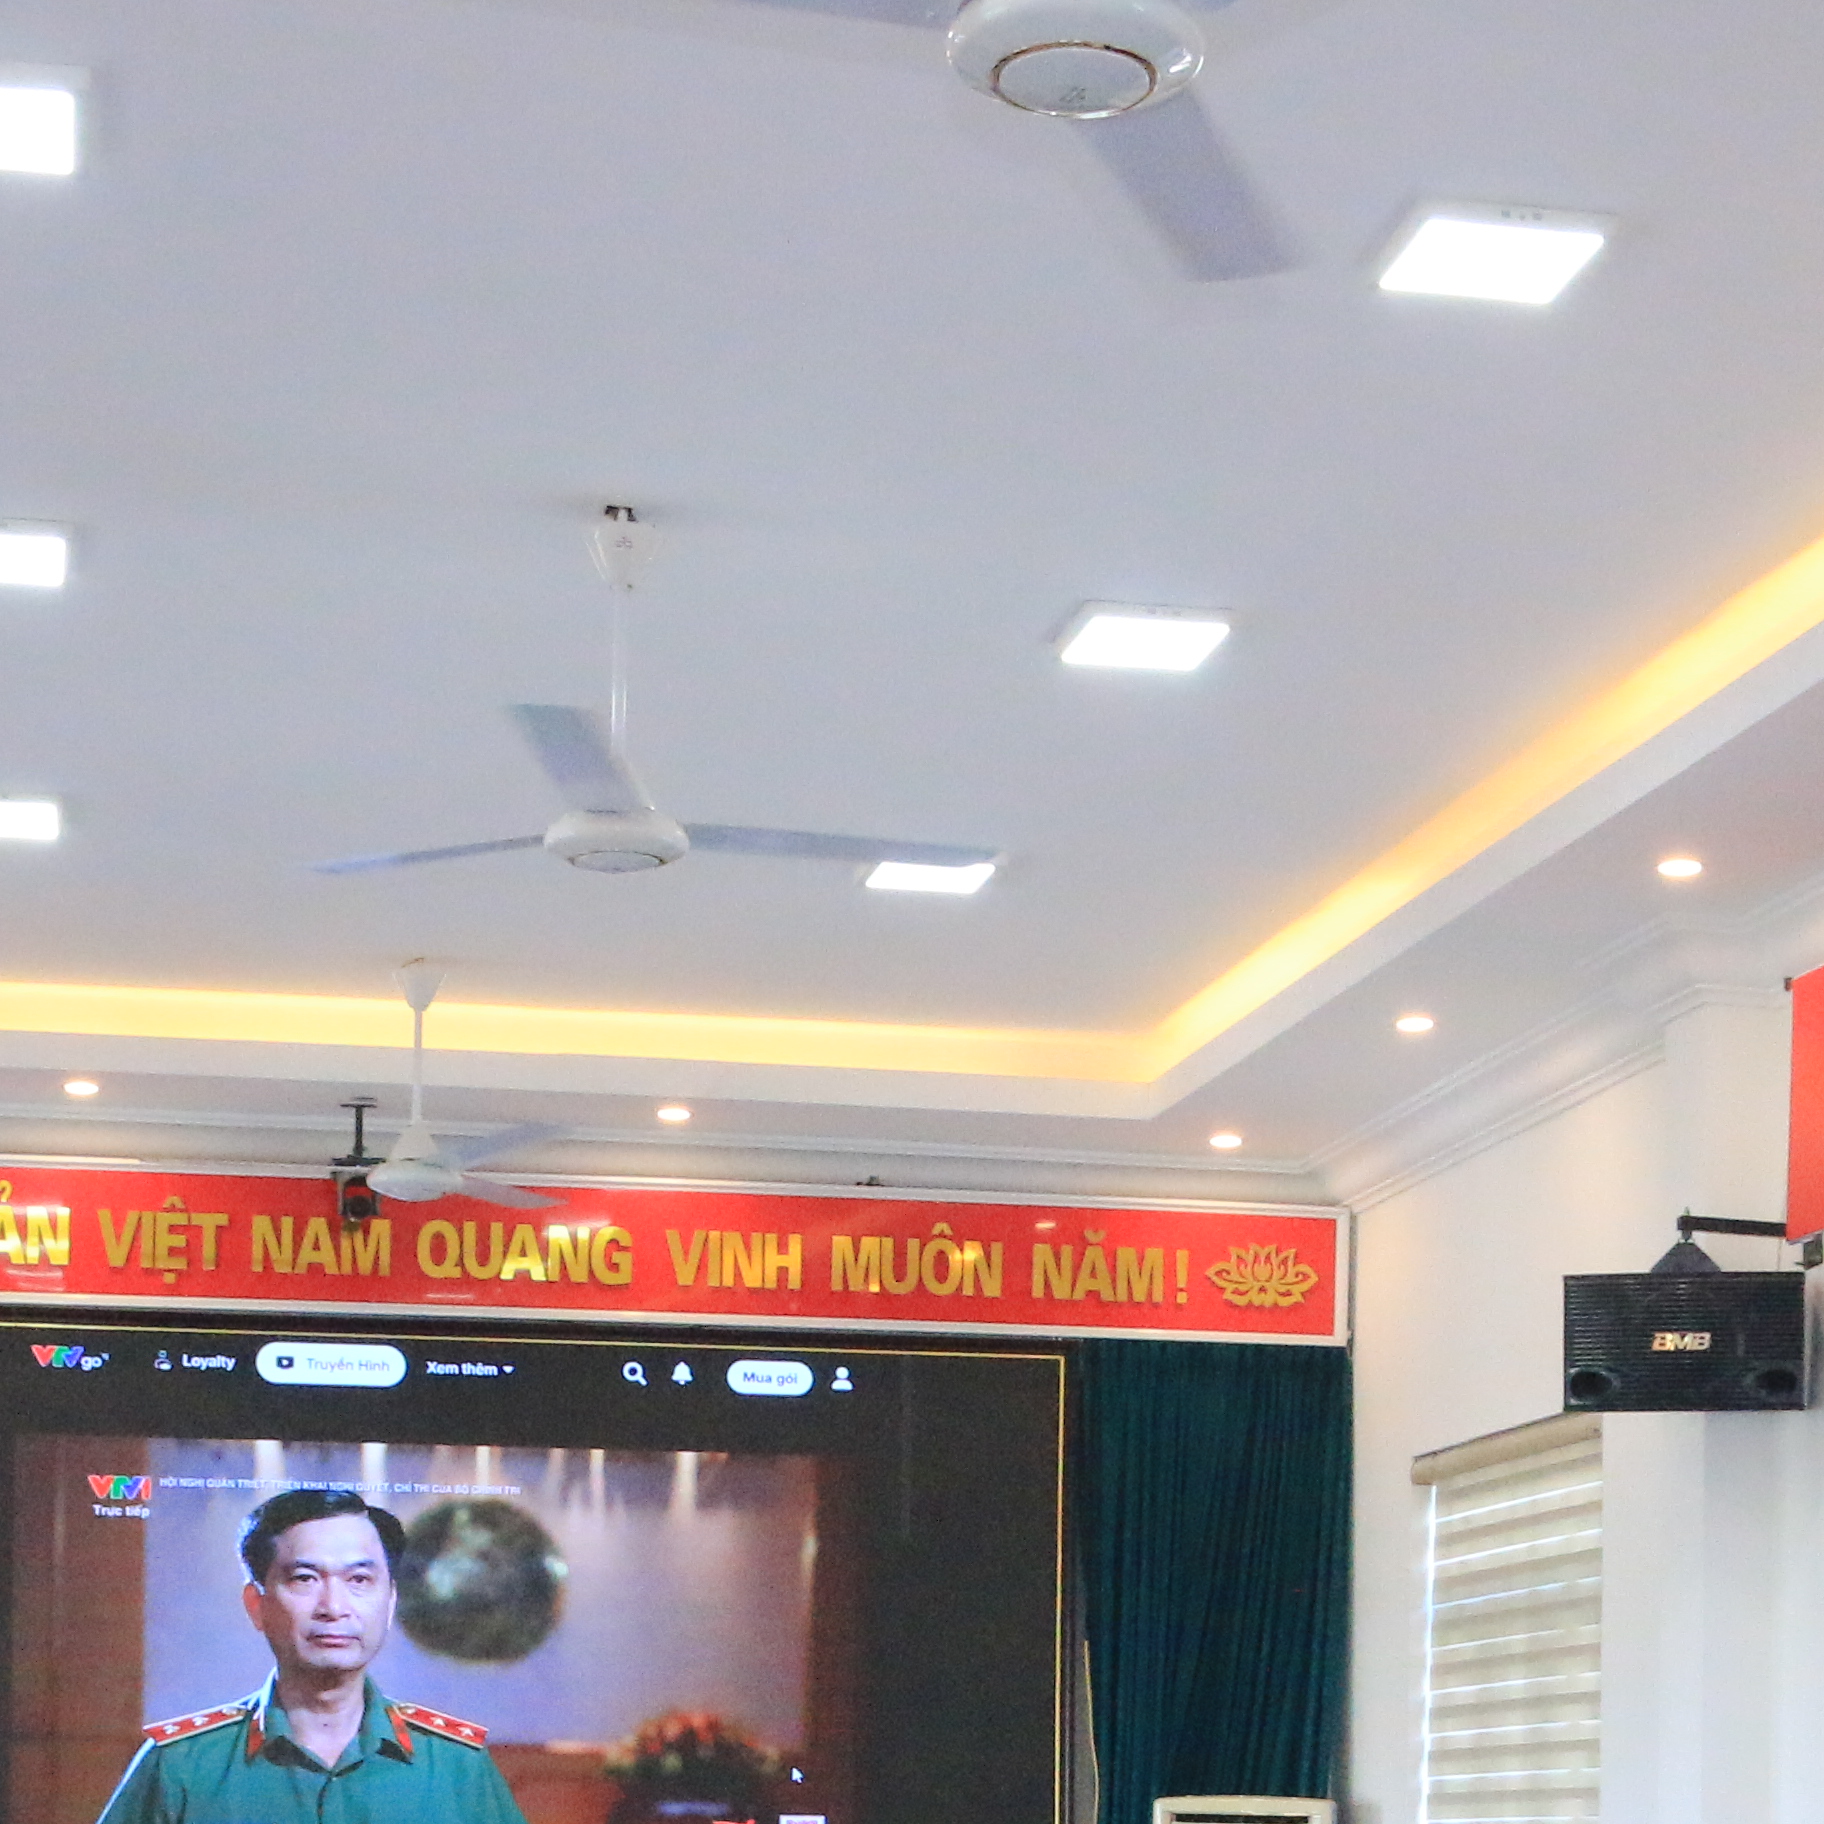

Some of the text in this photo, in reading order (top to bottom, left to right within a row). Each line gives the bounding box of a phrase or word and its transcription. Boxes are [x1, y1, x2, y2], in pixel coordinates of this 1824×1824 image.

[99, 1196, 229, 1285] VIỆT
[250, 1213, 391, 1277] NAM
[418, 1218, 633, 1287] QUANG
[666, 1229, 803, 1292] VINH
[830, 1222, 1004, 1298] MUÔN
[1032, 1231, 1189, 1304] NĂM!
[1651, 1331, 1712, 1351] BMB
[182, 1353, 237, 1371] Loyalty
[426, 1361, 459, 1375] Xem
[461, 1362, 498, 1376] thêm
[743, 1372, 772, 1384] Mua
[776, 1372, 797, 1386] gói
